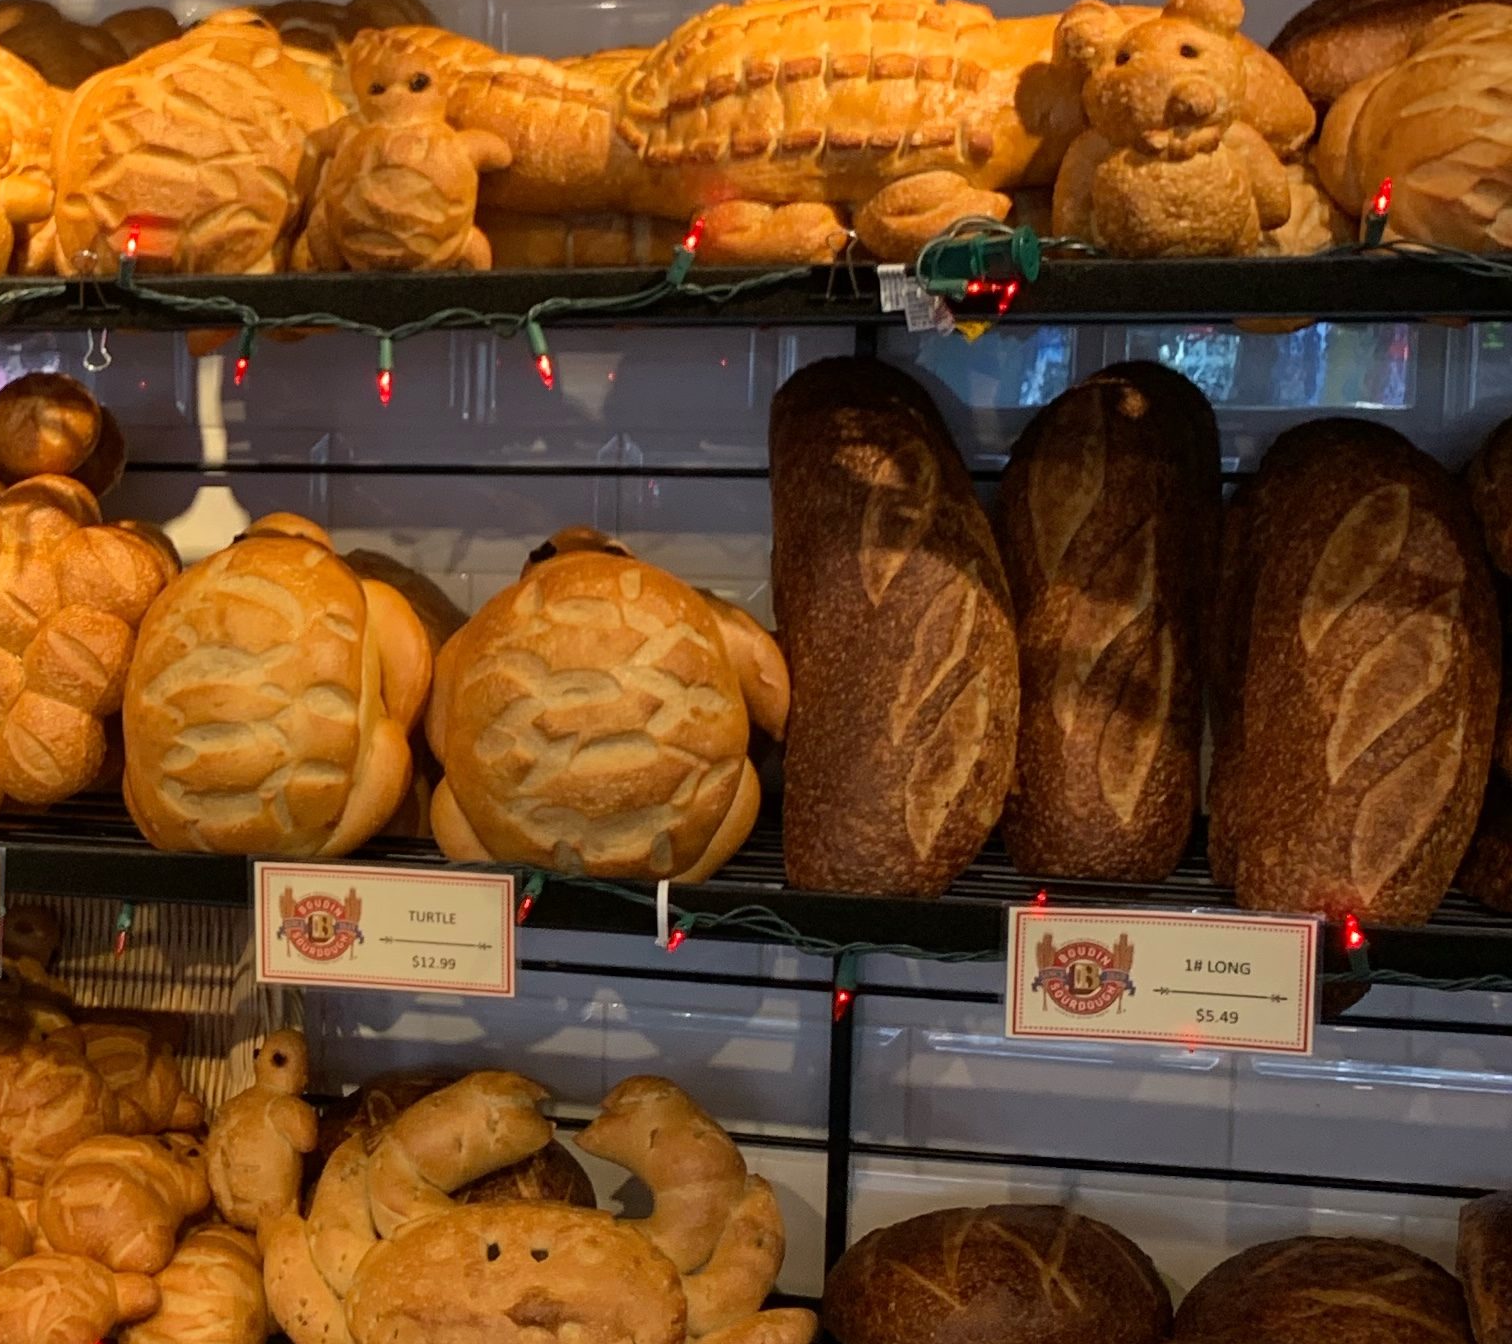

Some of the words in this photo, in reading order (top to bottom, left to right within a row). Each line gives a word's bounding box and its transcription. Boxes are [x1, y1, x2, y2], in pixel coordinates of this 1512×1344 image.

[297, 899, 344, 918] BOUDIN
[408, 910, 457, 925] TURTLE
[291, 930, 350, 958] SOURDOUGH
[412, 956, 456, 970] $12.99
[1057, 944, 1113, 967] BOUDIN
[1185, 959, 1203, 973] 1#
[1207, 960, 1251, 976] LONG
[1049, 980, 1118, 1012] SOURDOUGH
[1196, 1009, 1239, 1024] $5.49
